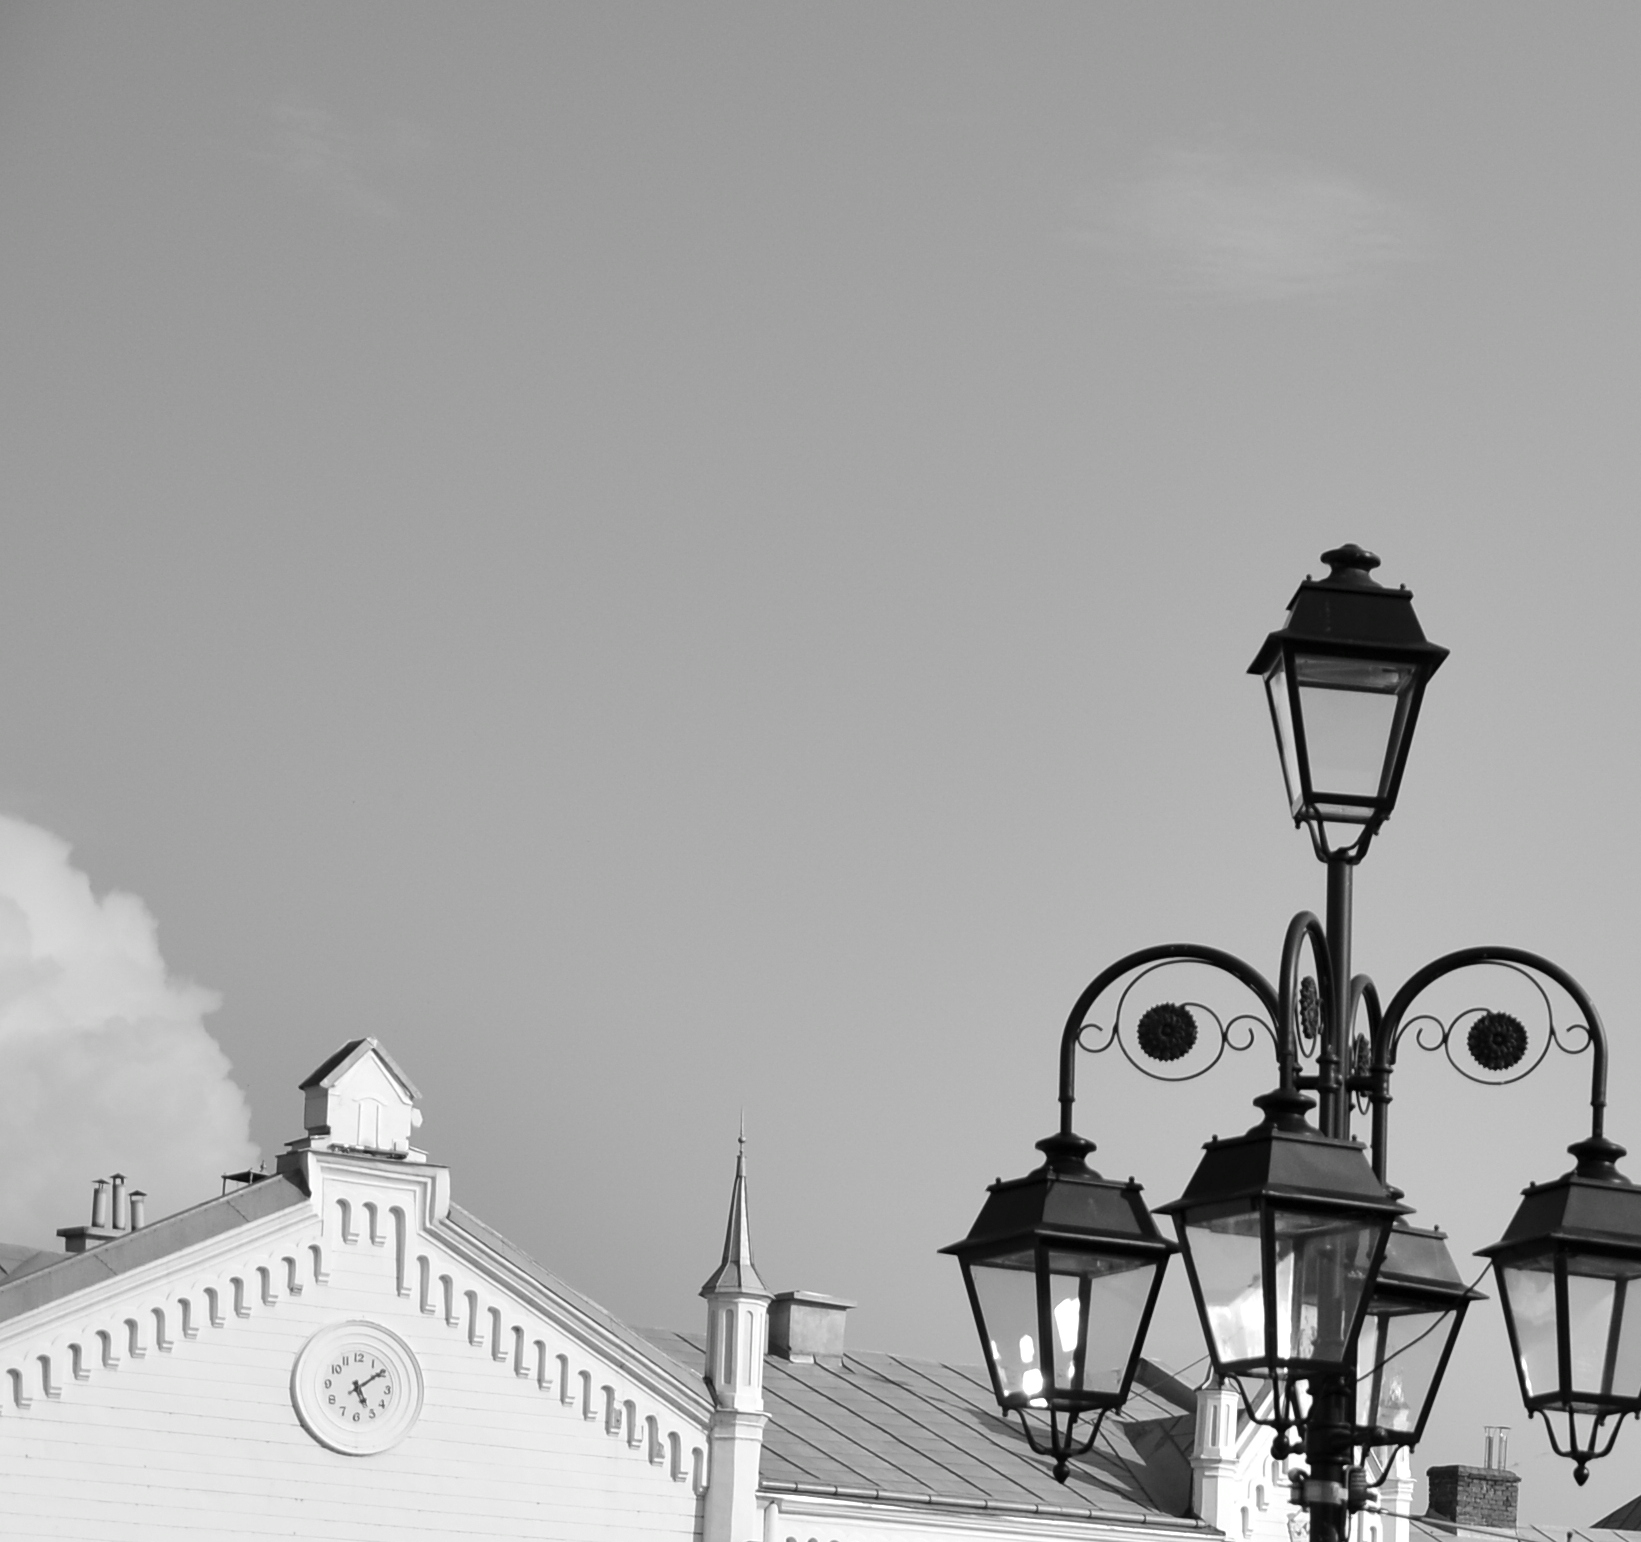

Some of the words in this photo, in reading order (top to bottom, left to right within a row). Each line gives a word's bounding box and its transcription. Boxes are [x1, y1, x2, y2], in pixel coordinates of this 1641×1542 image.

[342, 1356, 349, 1366] 11
[354, 1352, 364, 1363] 12
[331, 1364, 342, 1374] 10
[324, 1379, 332, 1389] 9
[383, 1385, 391, 1395] 3
[328, 1394, 336, 1405] 8
[378, 1399, 385, 1409] 4
[339, 1406, 346, 1416] 7
[368, 1408, 376, 1419] 5
[352, 1412, 360, 1422] 6
